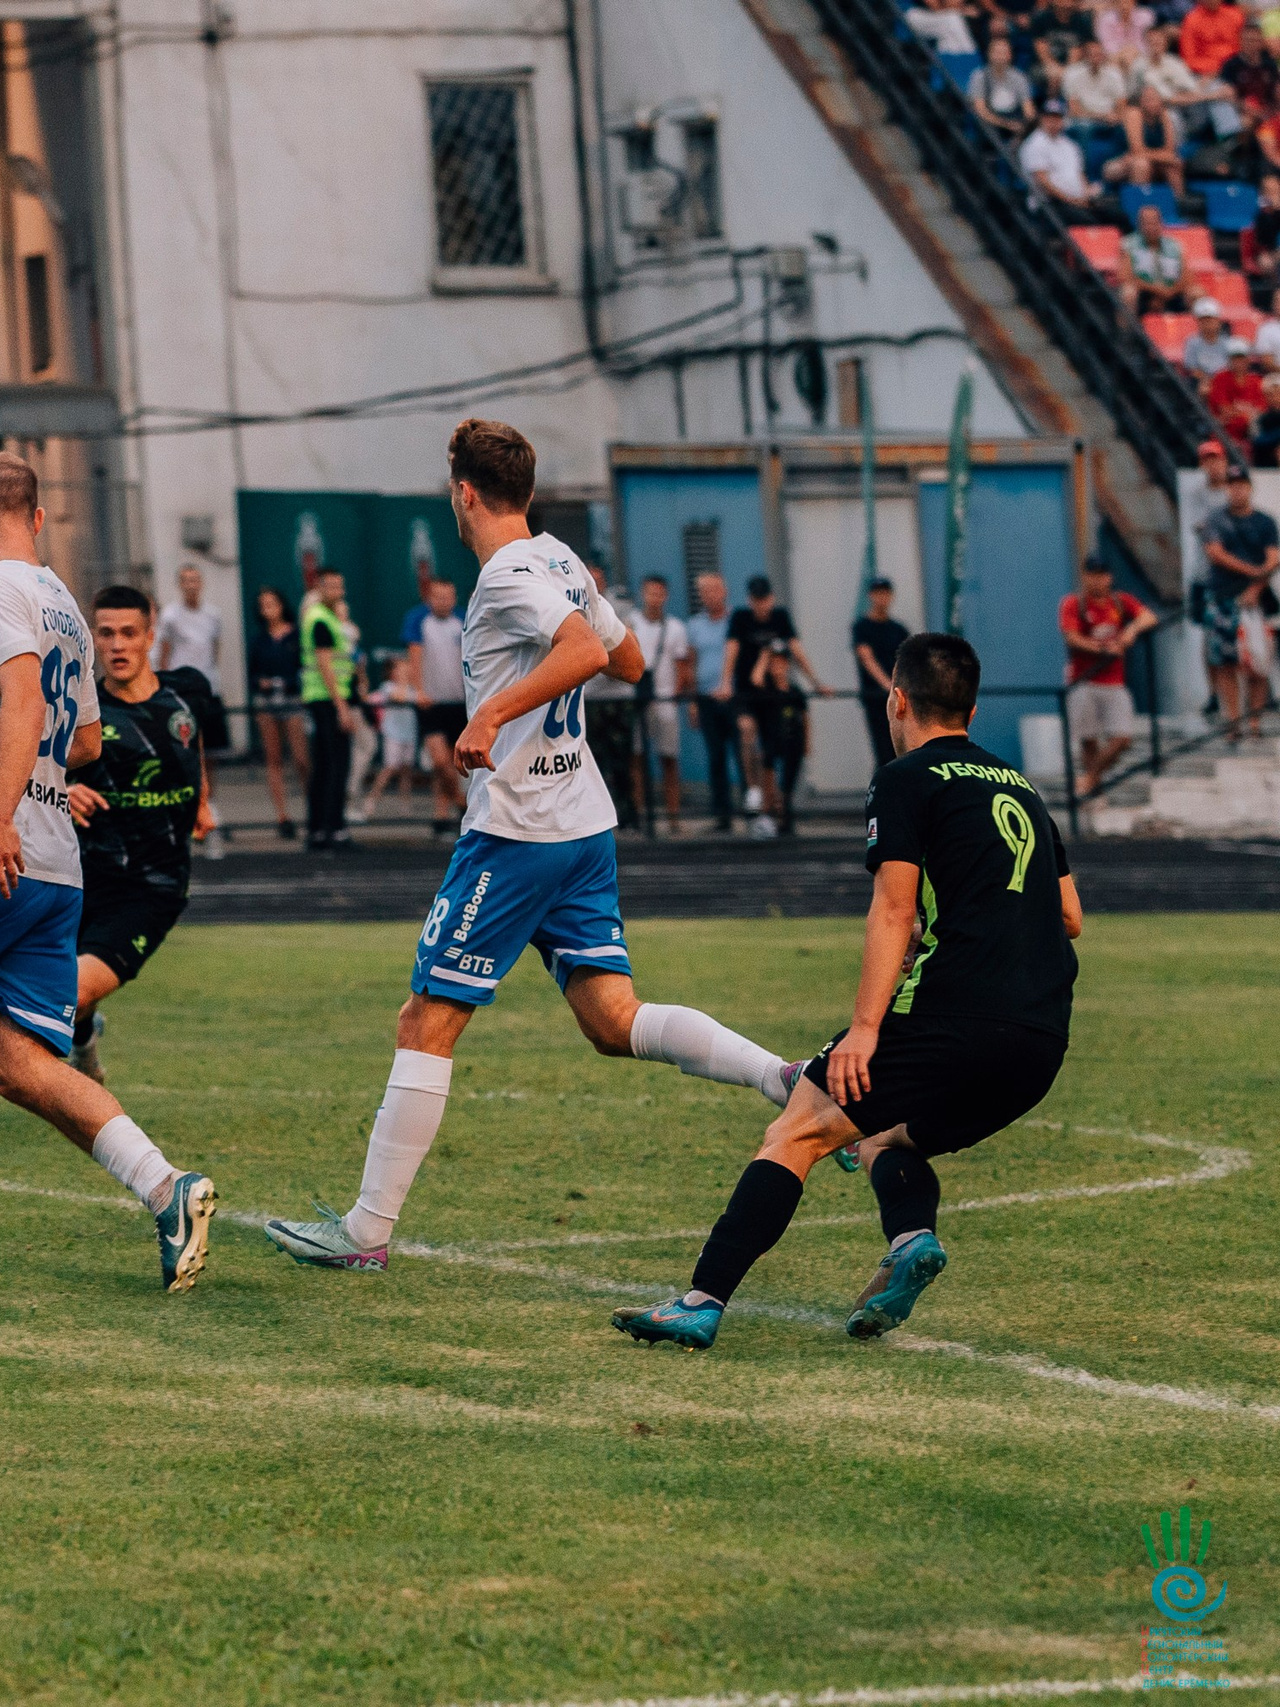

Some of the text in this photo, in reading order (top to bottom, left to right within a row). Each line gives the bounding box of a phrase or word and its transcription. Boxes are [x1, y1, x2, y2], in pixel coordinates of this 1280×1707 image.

[29, 645, 81, 769] 86
[991, 792, 1036, 893] 9
[419, 893, 450, 947] 8
[452, 870, 493, 943] BetBoom
[458, 953, 496, 976] ВТБ
